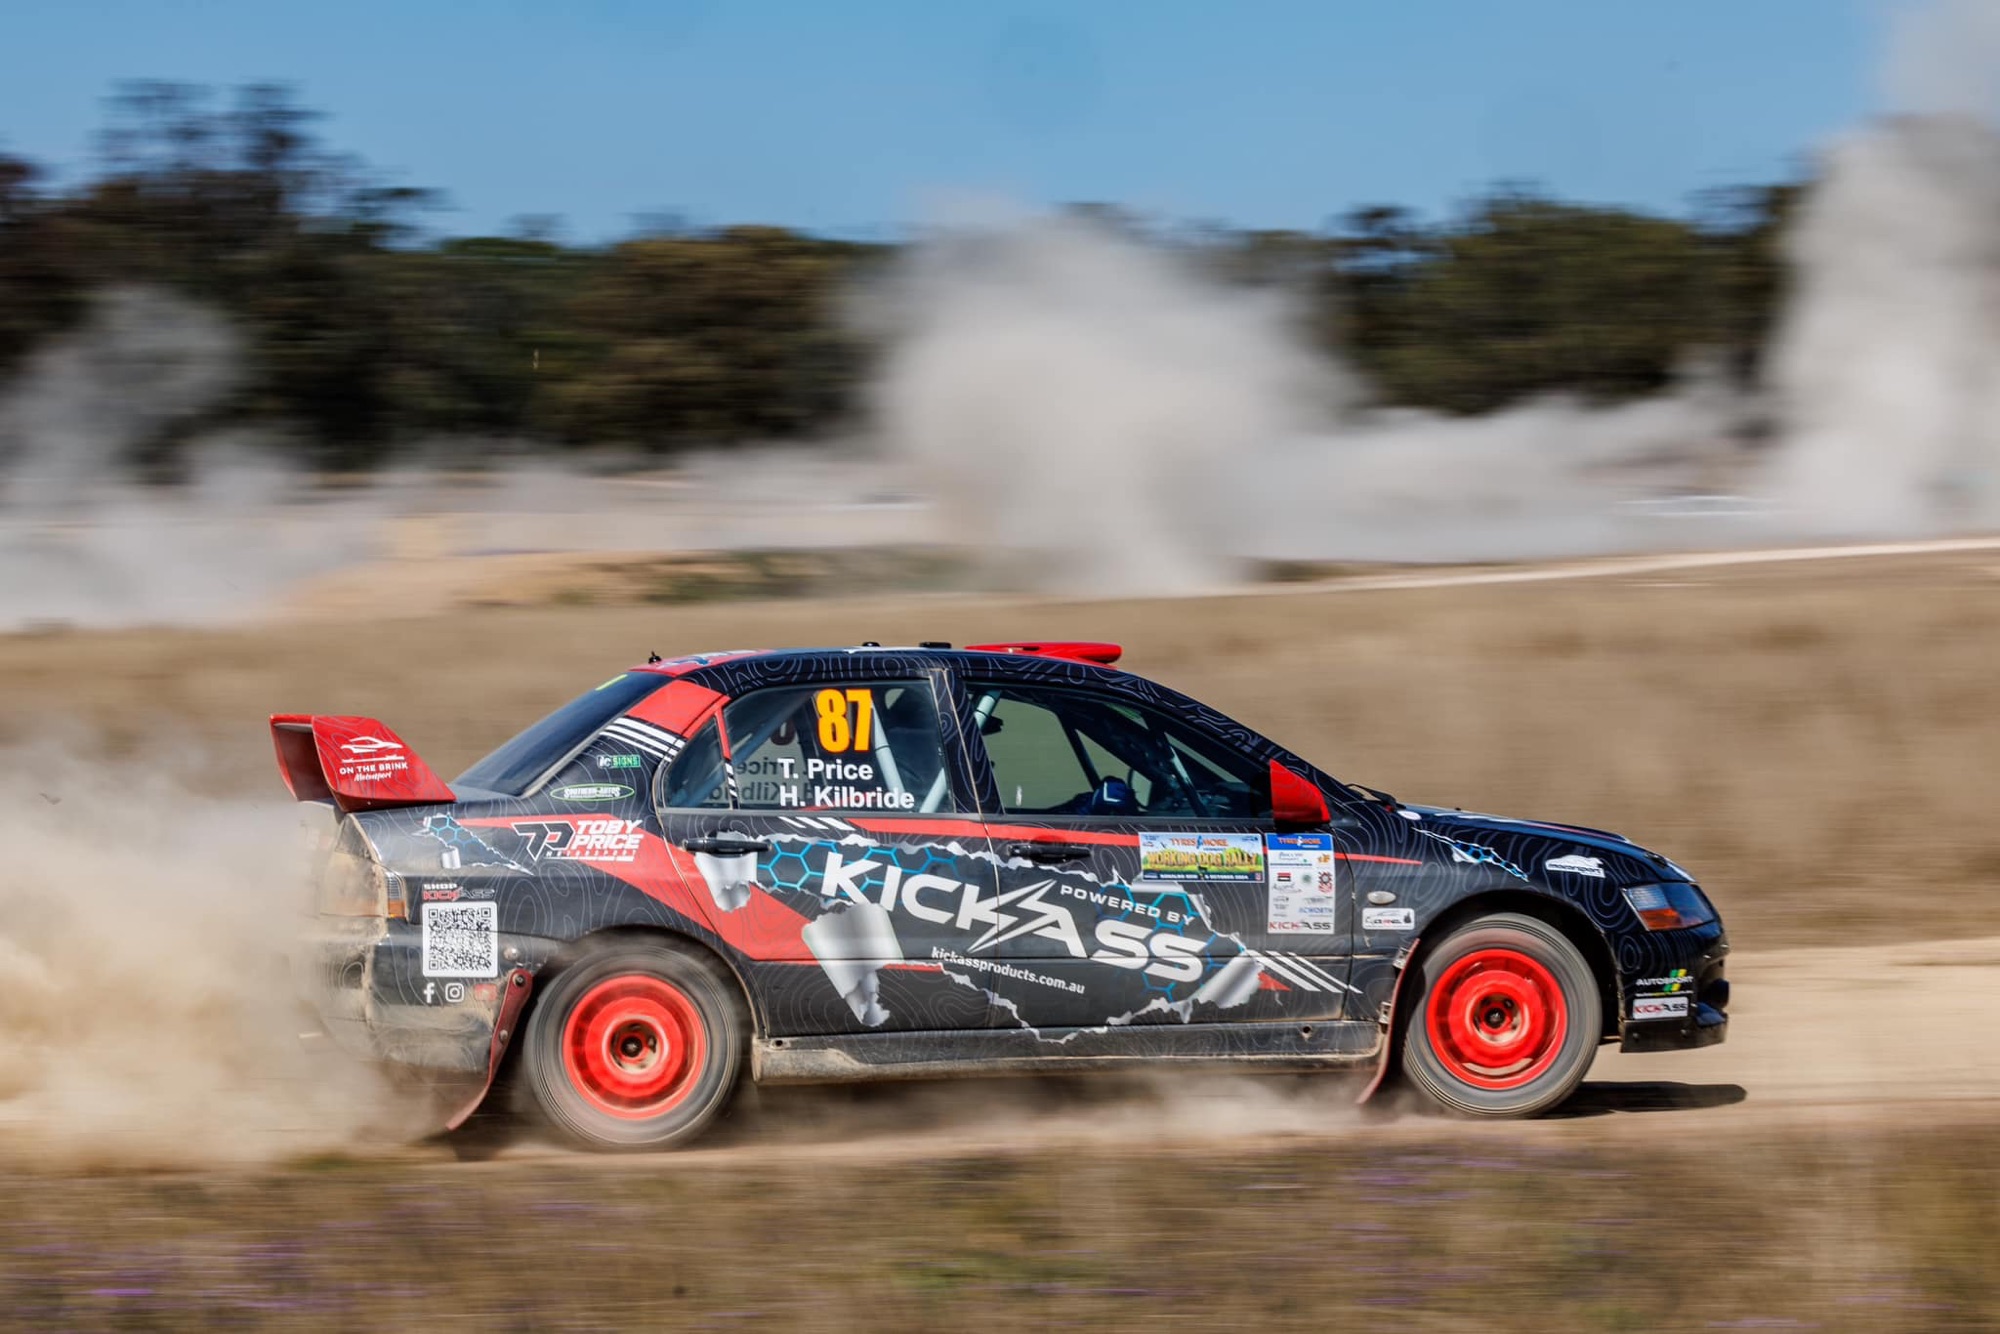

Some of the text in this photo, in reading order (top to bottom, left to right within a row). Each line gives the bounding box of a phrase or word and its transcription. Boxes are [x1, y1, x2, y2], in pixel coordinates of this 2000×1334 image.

[816, 688, 873, 752] 87
[339, 762, 408, 775] ON THE BRINK
[777, 758, 873, 780] T. Price
[780, 785, 915, 809] H. Kilbride
[577, 820, 643, 834] TOBY
[571, 834, 644, 849] PRICE
[1171, 838, 1196, 846] TYRES
[1203, 839, 1228, 847] MORE
[1148, 851, 1257, 866] WORKING DOG RALLY
[423, 887, 495, 901] KICKASS
[1060, 885, 1195, 926] POWERED BY
[1269, 921, 1331, 930] KICKASS
[931, 947, 1086, 994] kickassproducts.com.au
[1635, 976, 1694, 986] AUTOSPORT
[1635, 1003, 1688, 1013] KICKASS
